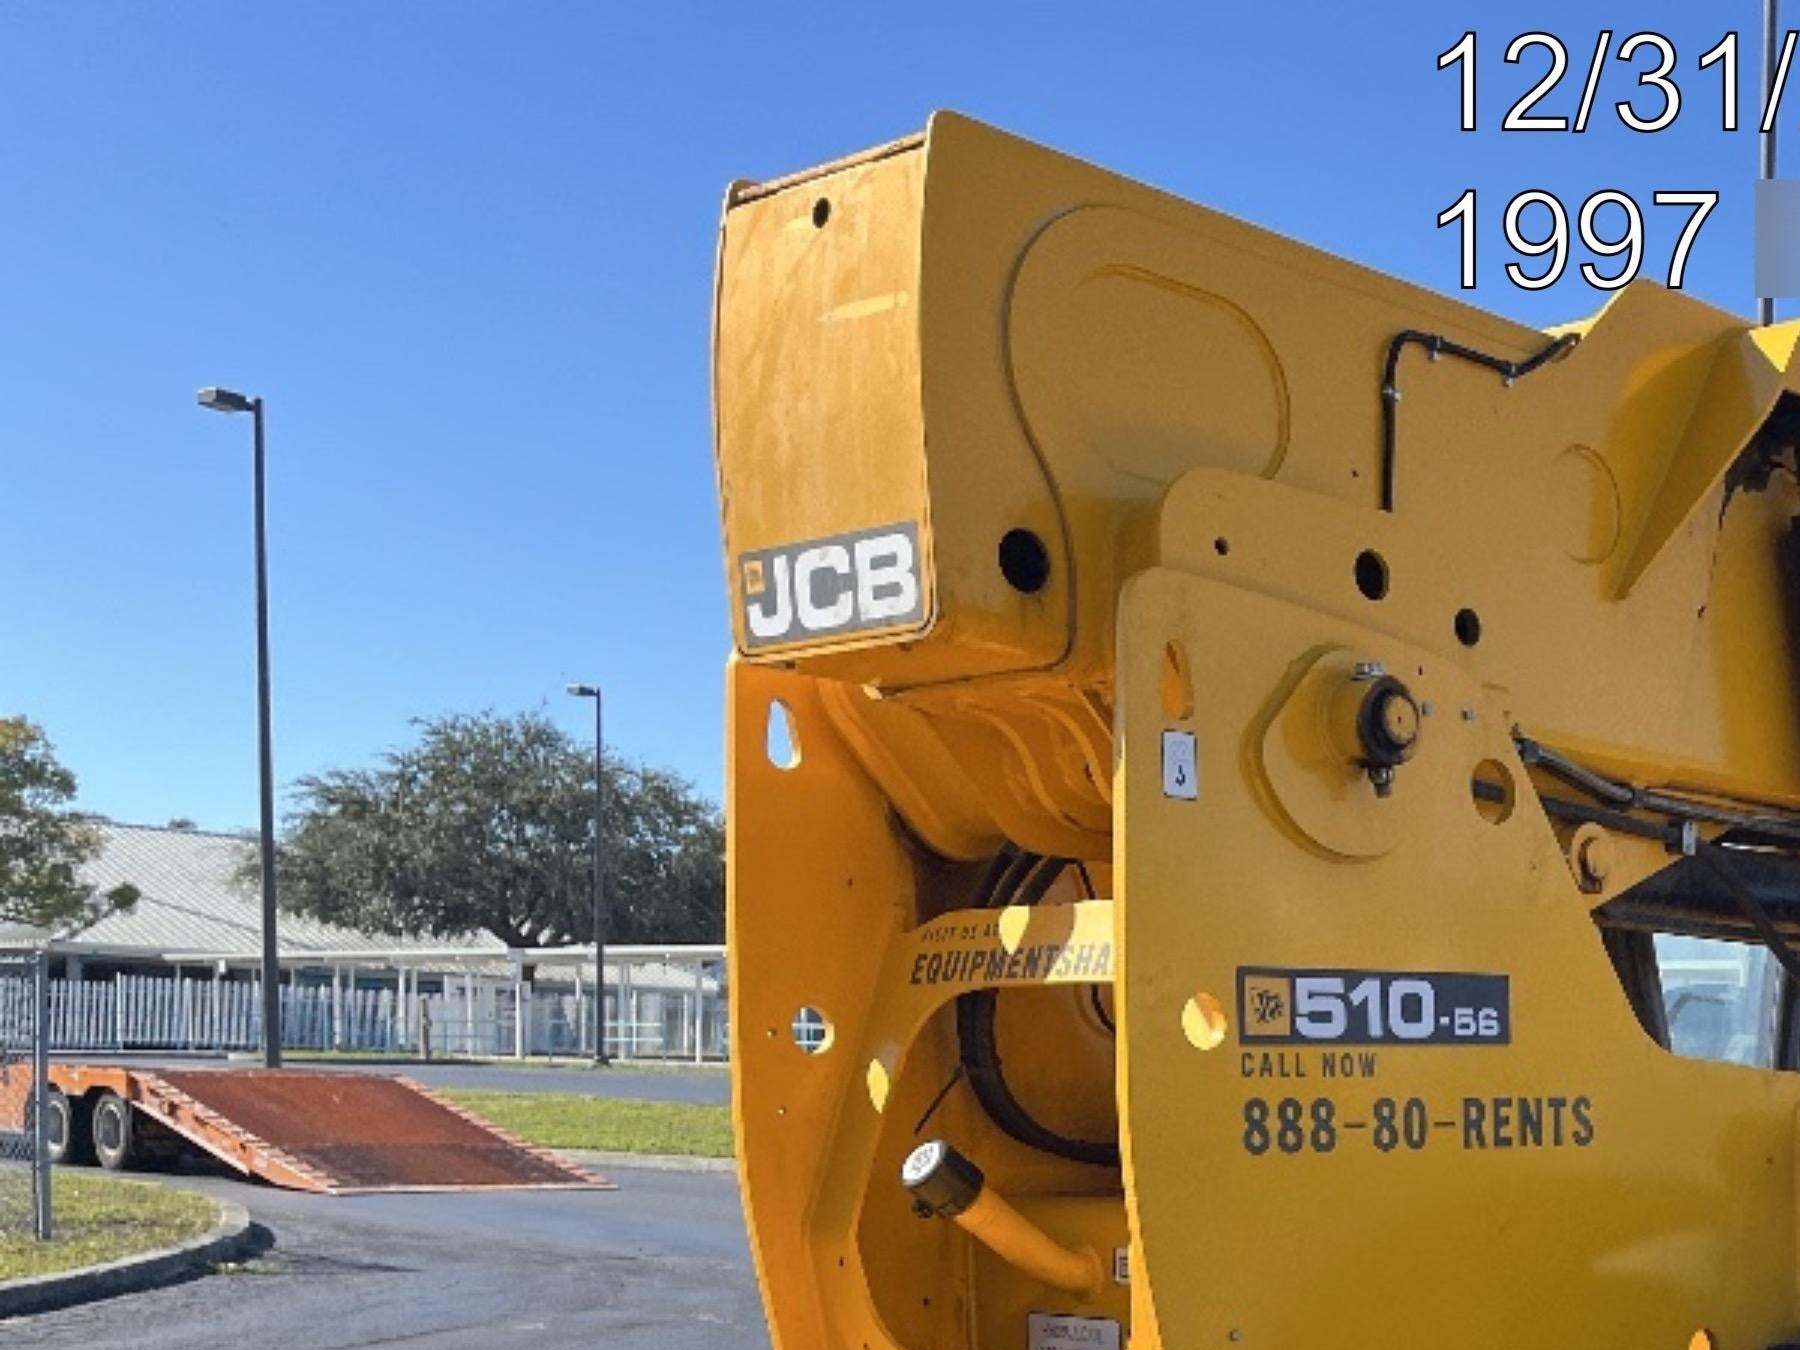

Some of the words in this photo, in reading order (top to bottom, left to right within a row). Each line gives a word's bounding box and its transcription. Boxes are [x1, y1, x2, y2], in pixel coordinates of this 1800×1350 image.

[747, 533, 919, 637] JCB
[909, 941, 1116, 985] EQUIPMENTSHA
[1240, 1052, 1306, 1078] CALL
[1322, 1052, 1376, 1078] NOW
[1243, 1095, 1595, 1156] 888-80-RENTS
